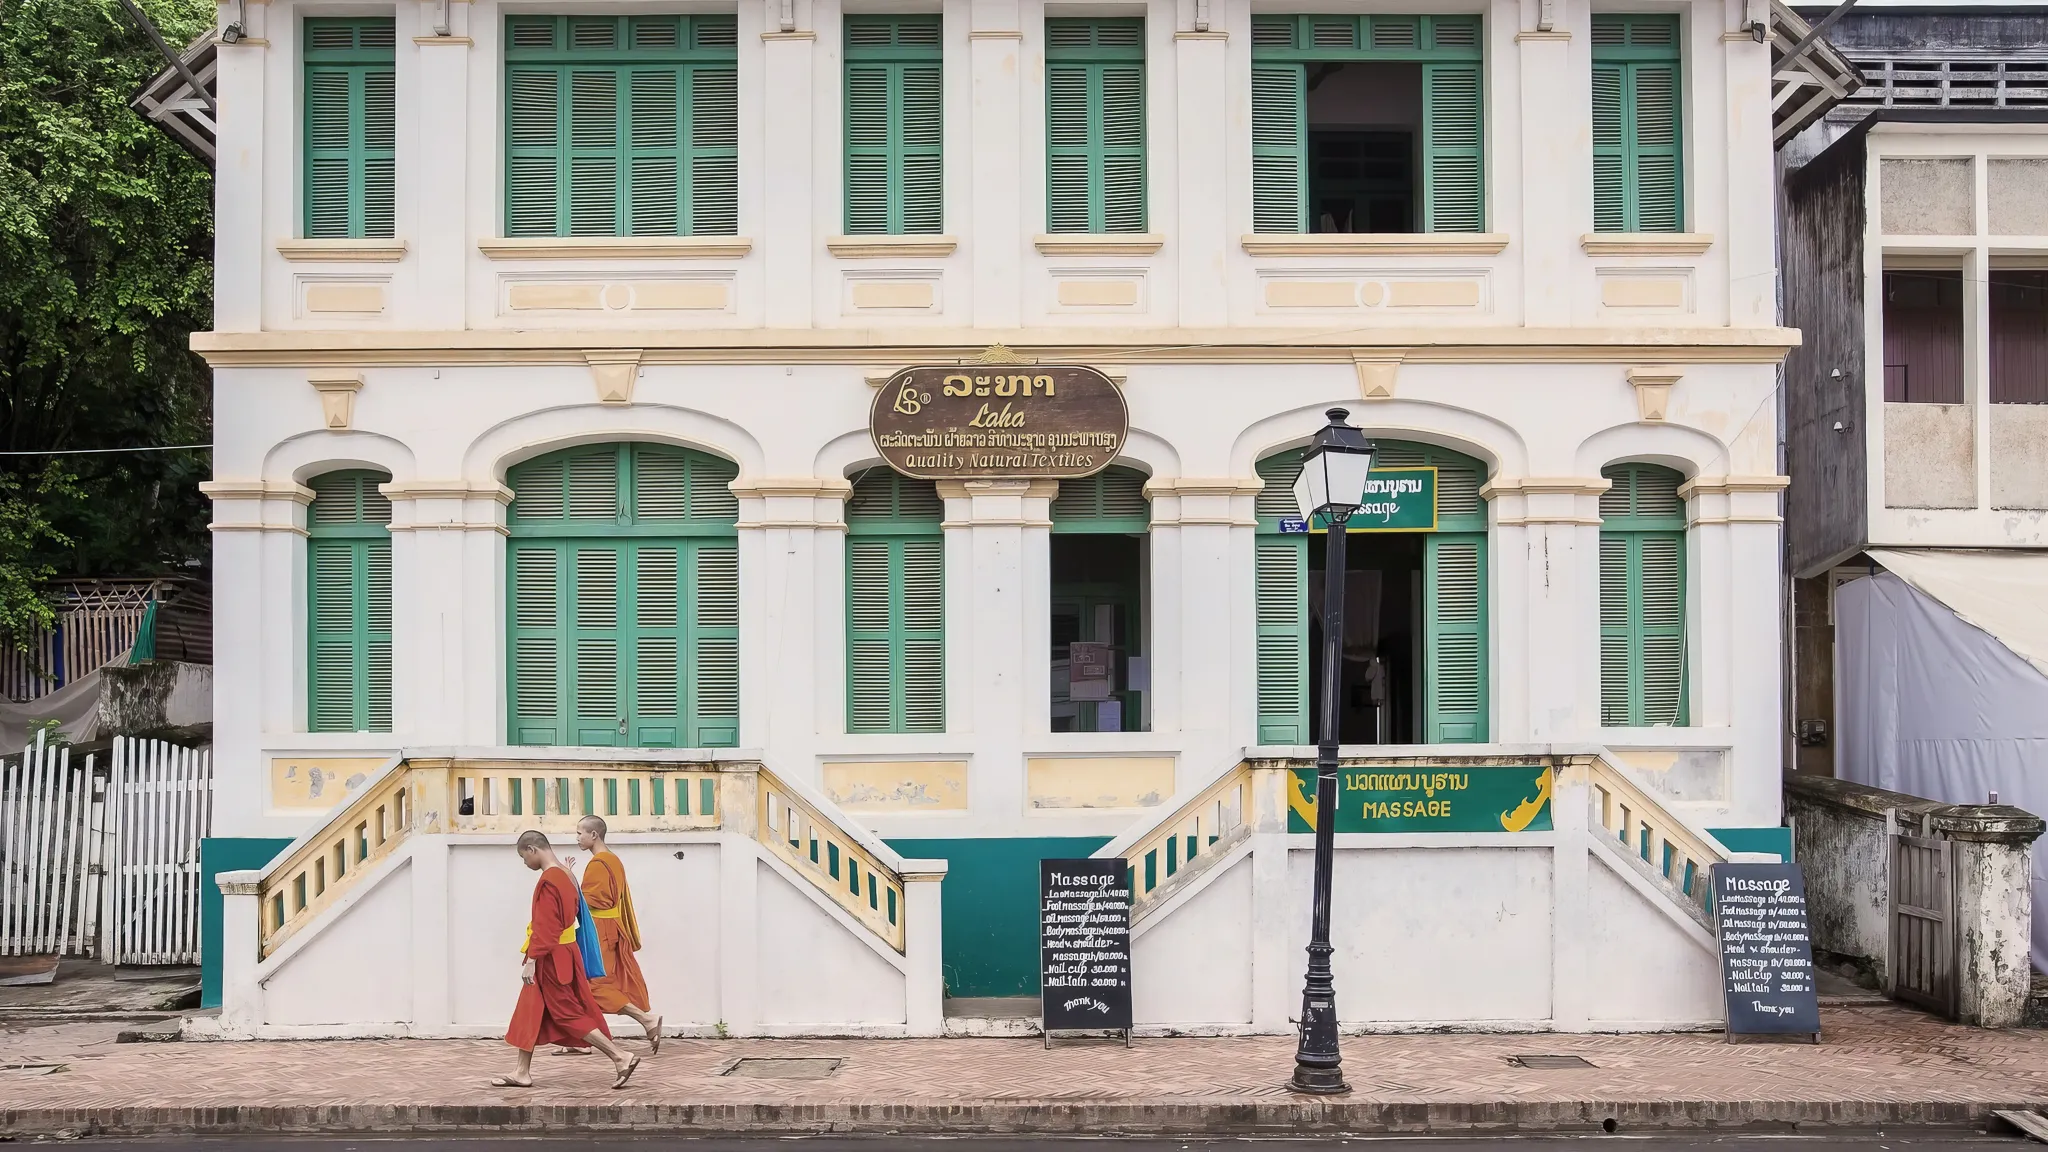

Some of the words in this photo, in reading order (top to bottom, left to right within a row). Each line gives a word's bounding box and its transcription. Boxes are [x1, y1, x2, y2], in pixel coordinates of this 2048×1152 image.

[968, 402, 1026, 428] Laha
[906, 453, 964, 470] Quality
[969, 453, 1027, 468] Natural
[1031, 452, 1094, 468] Textiles
[1347, 502, 1400, 523] ssage
[1363, 801, 1451, 819] MASSAGE
[1051, 872, 1115, 891] Massage
[1726, 876, 1790, 896] Massage
[1087, 999, 1110, 1014] you
